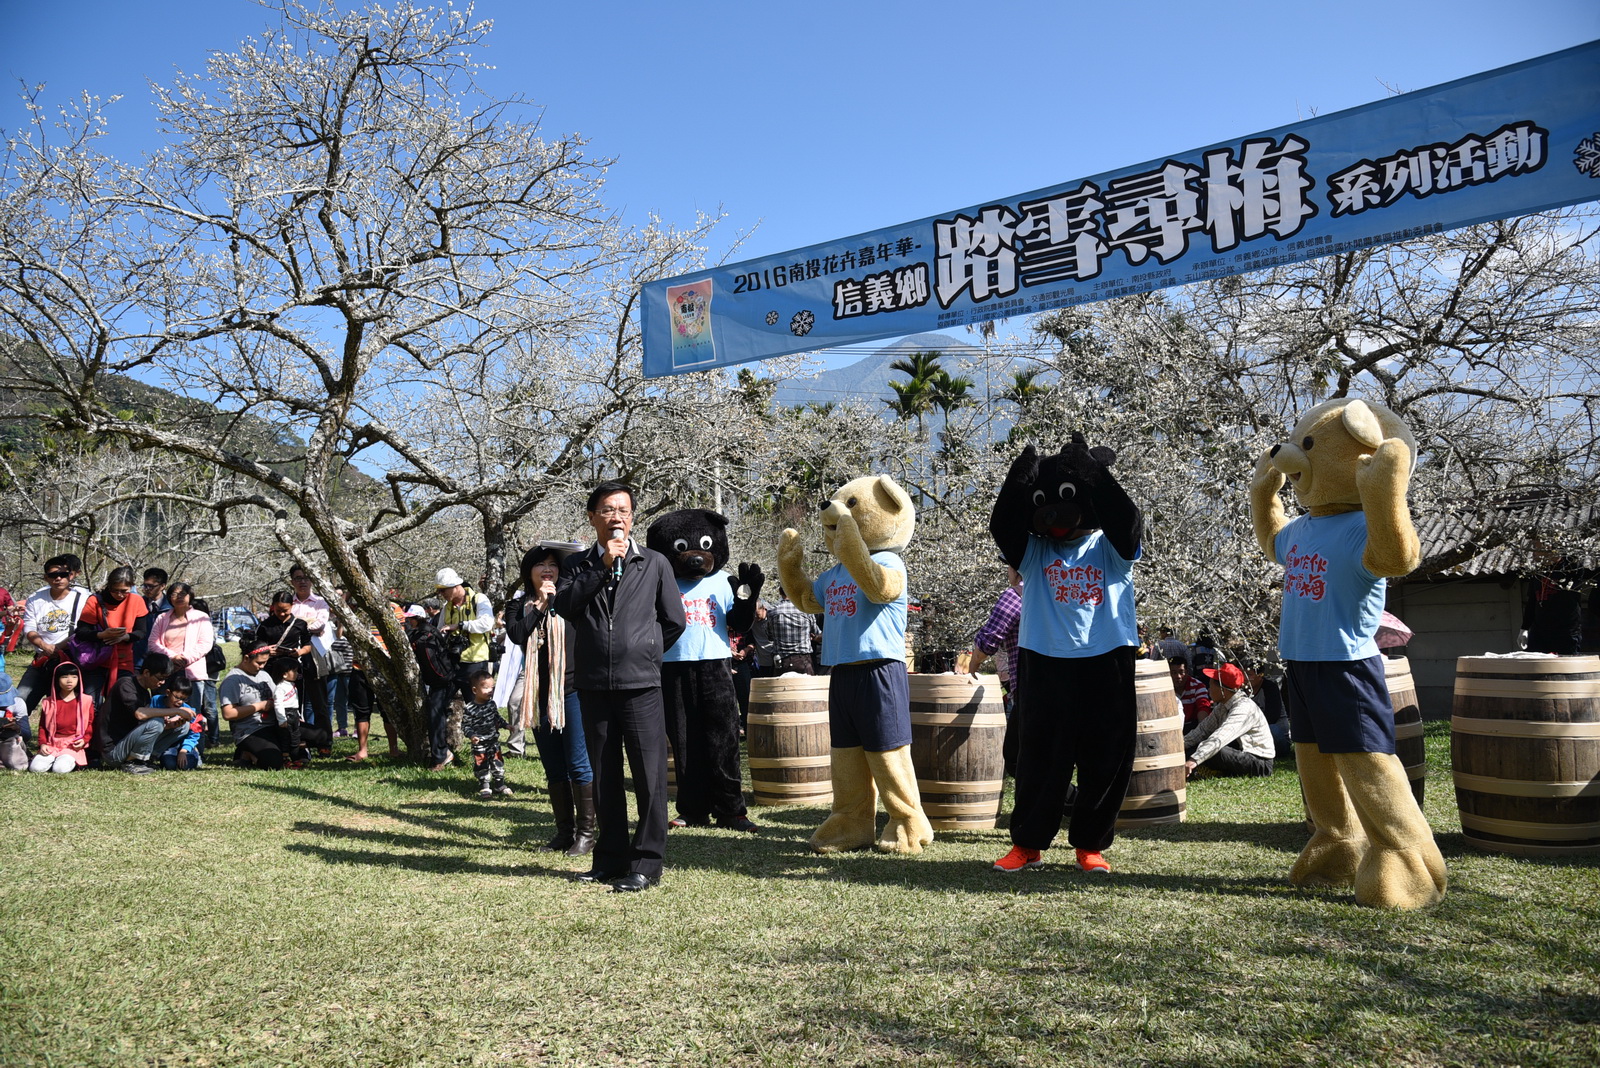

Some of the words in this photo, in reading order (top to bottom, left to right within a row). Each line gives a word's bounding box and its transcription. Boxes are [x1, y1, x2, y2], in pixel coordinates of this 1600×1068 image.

[1327, 120, 1549, 218] 系列活動
[933, 133, 1319, 309] 踏雪尋梅
[833, 262, 931, 320] 信義鄉
